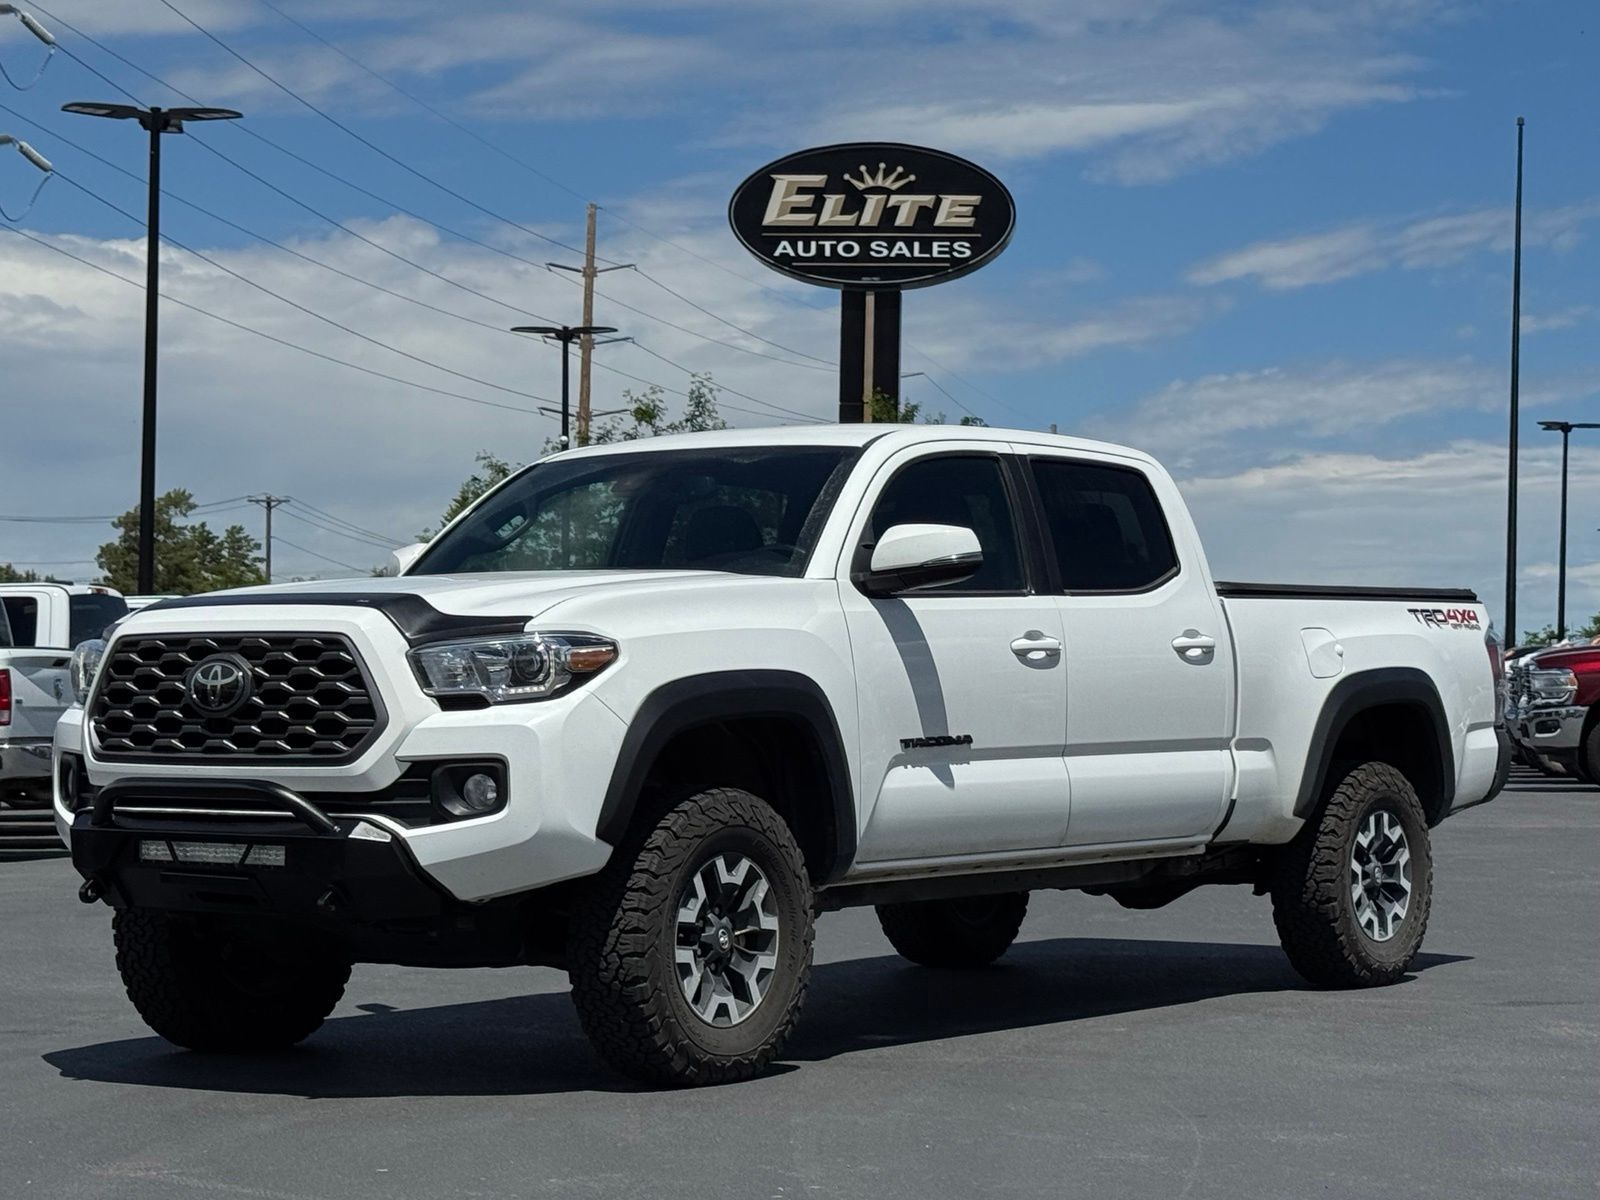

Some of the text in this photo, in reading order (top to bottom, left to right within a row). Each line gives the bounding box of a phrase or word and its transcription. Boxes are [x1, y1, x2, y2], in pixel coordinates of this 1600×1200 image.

[762, 174, 982, 227] ELITE
[773, 240, 972, 258] AUTO SALES
